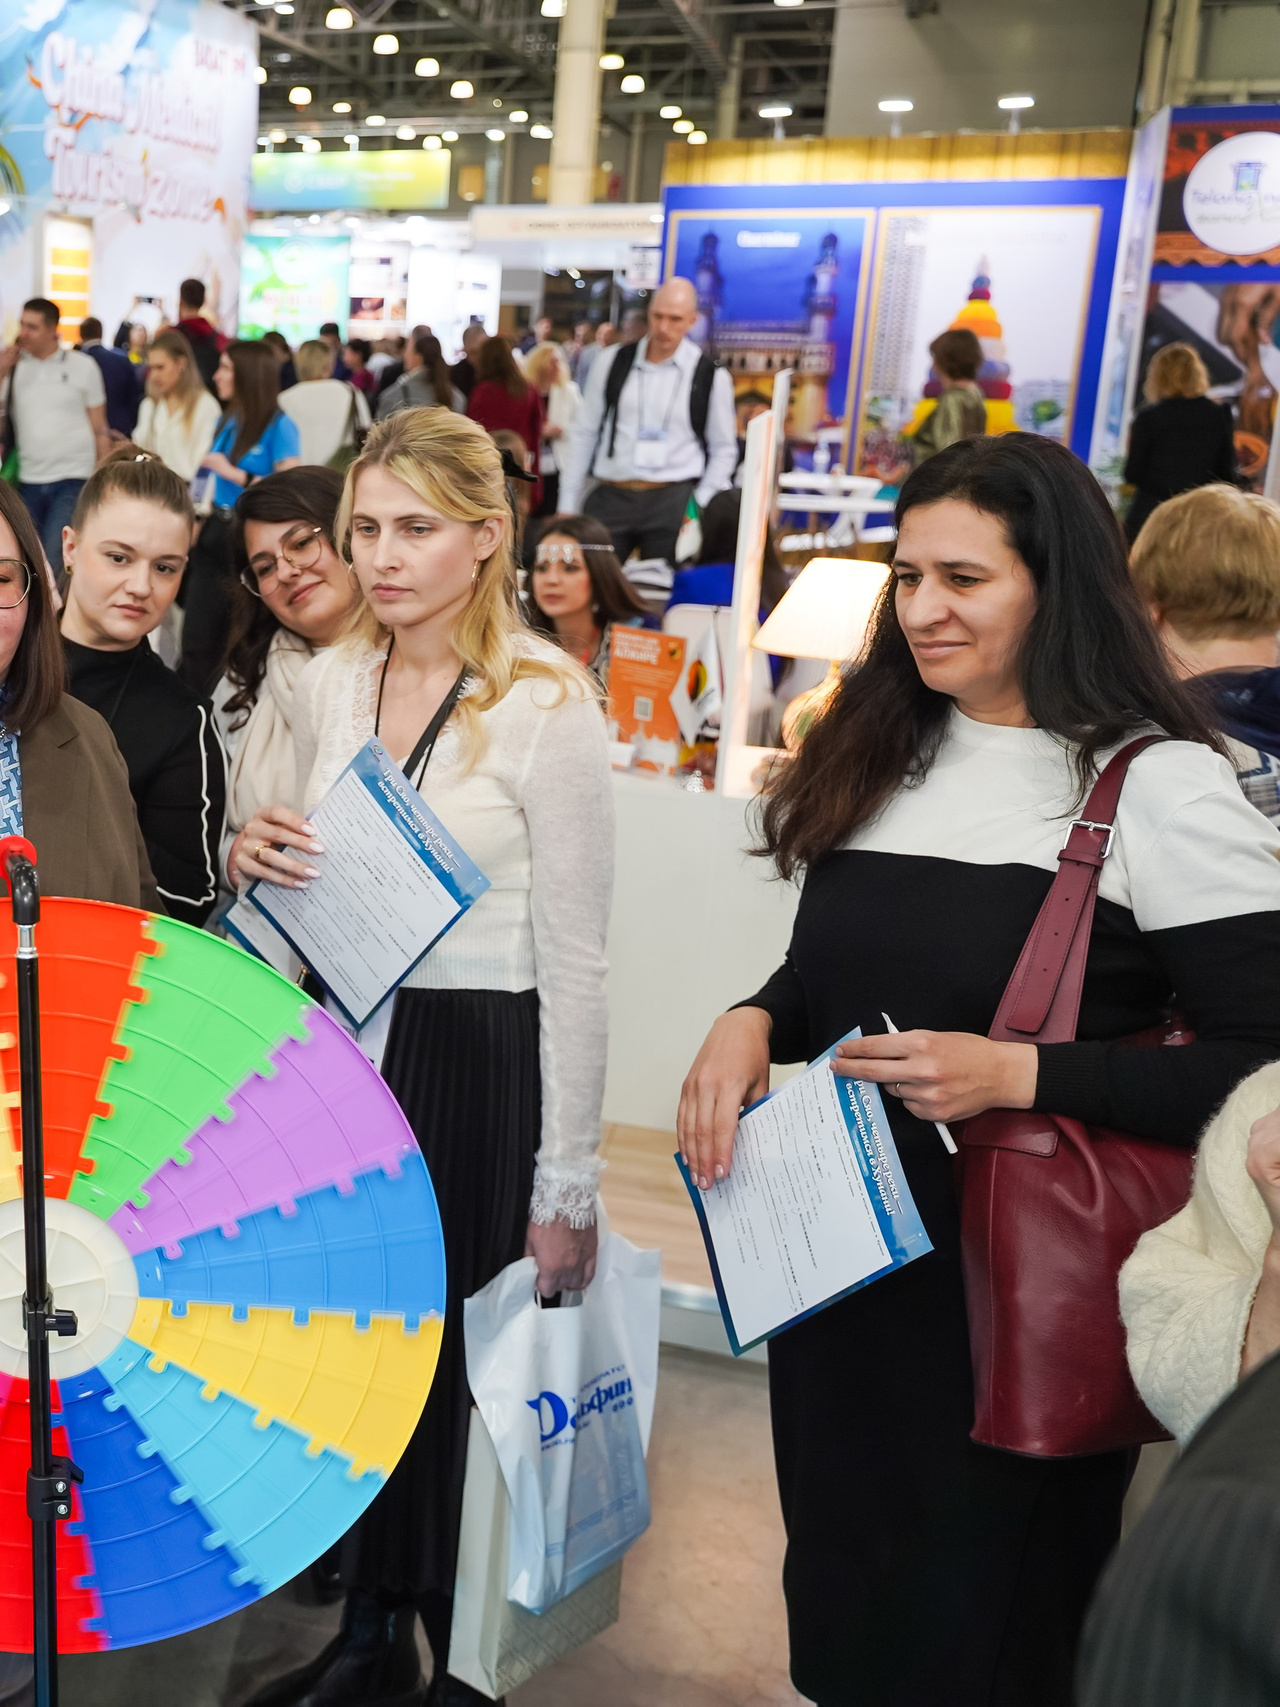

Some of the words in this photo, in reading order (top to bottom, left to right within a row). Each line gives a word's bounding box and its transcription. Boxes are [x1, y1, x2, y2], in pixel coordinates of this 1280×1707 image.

[378, 780, 420, 833] встретимся
[422, 835, 454, 873] Хунани!
[382, 767, 398, 789] Три
[395, 785, 411, 806] Сяо,
[411, 803, 437, 841] четыре
[433, 837, 453, 858] реки
[846, 1083, 873, 1156] встретимся
[854, 1080, 868, 1097] ри
[861, 1093, 875, 1122] Сяо,
[871, 1121, 890, 1171] четыре
[883, 1170, 899, 1199] реки
[869, 1157, 878, 1165] в
[871, 1163, 897, 1216] Хунани!
